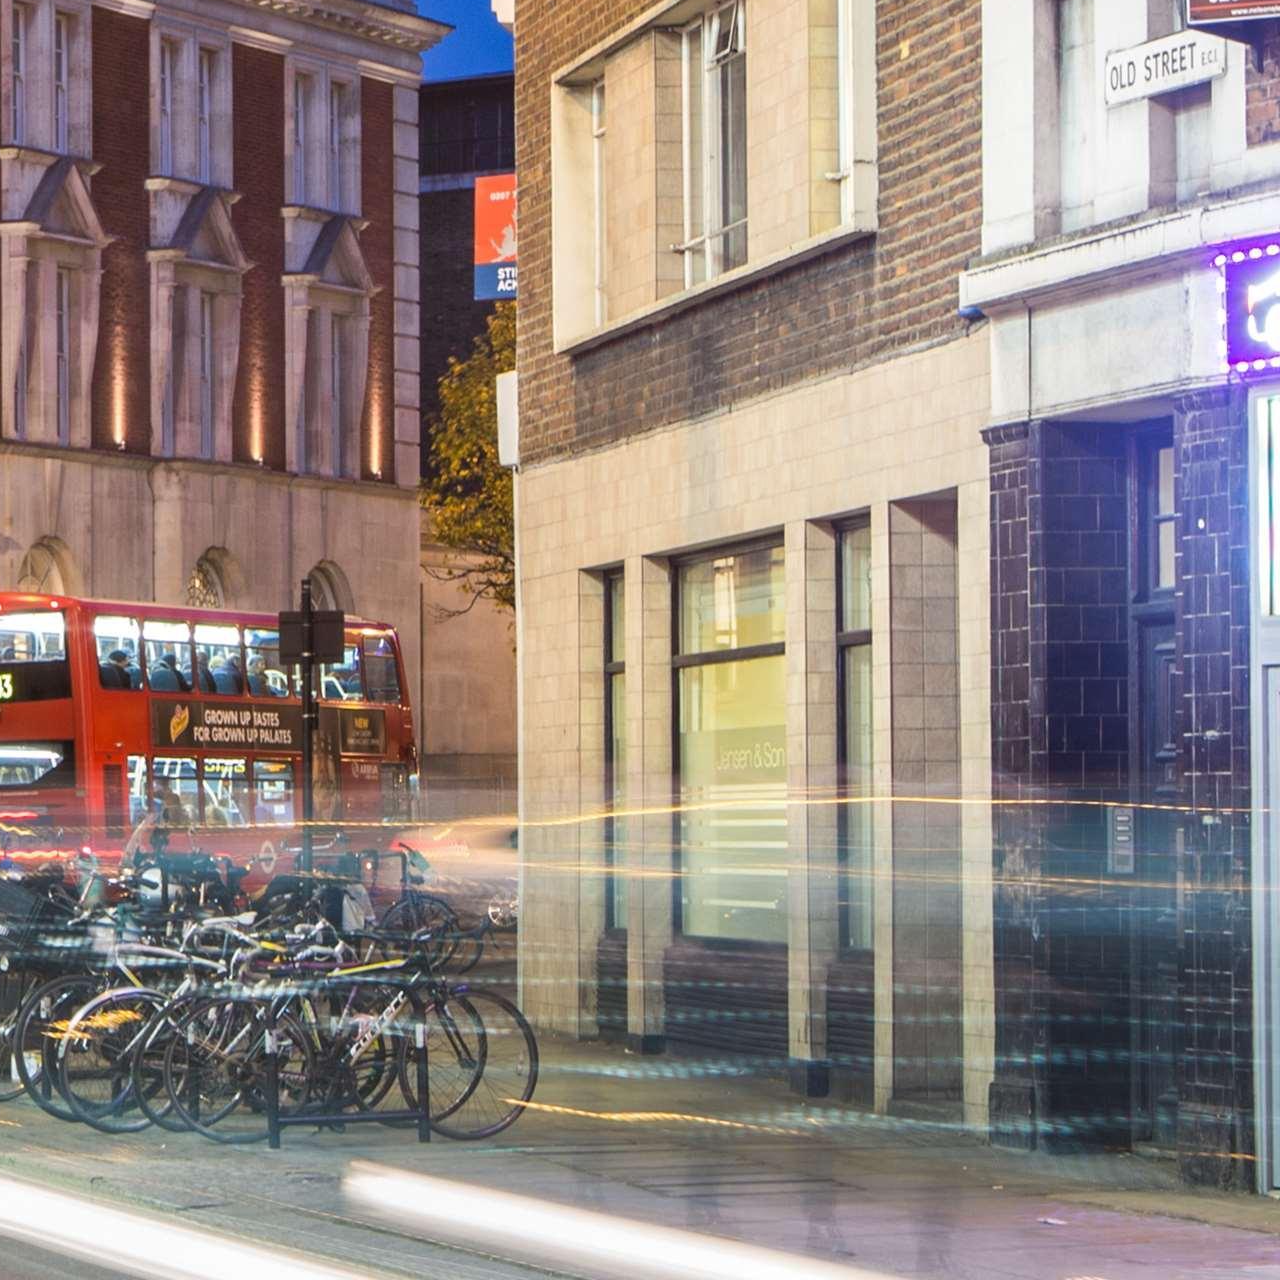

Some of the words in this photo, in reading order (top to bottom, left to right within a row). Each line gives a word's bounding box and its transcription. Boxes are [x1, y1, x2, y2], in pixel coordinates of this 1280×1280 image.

[1110, 61, 1136, 91] OLD
[1144, 42, 1197, 82] STREET
[205, 709, 238, 725] GROWN
[240, 710, 251, 725] UP
[253, 712, 280, 727] TASTES
[193, 727, 210, 742] FOR
[212, 727, 246, 743] GROWN
[247, 729, 258, 743] UP
[260, 730, 292, 744] PALATES
[753, 743, 762, 769] &
